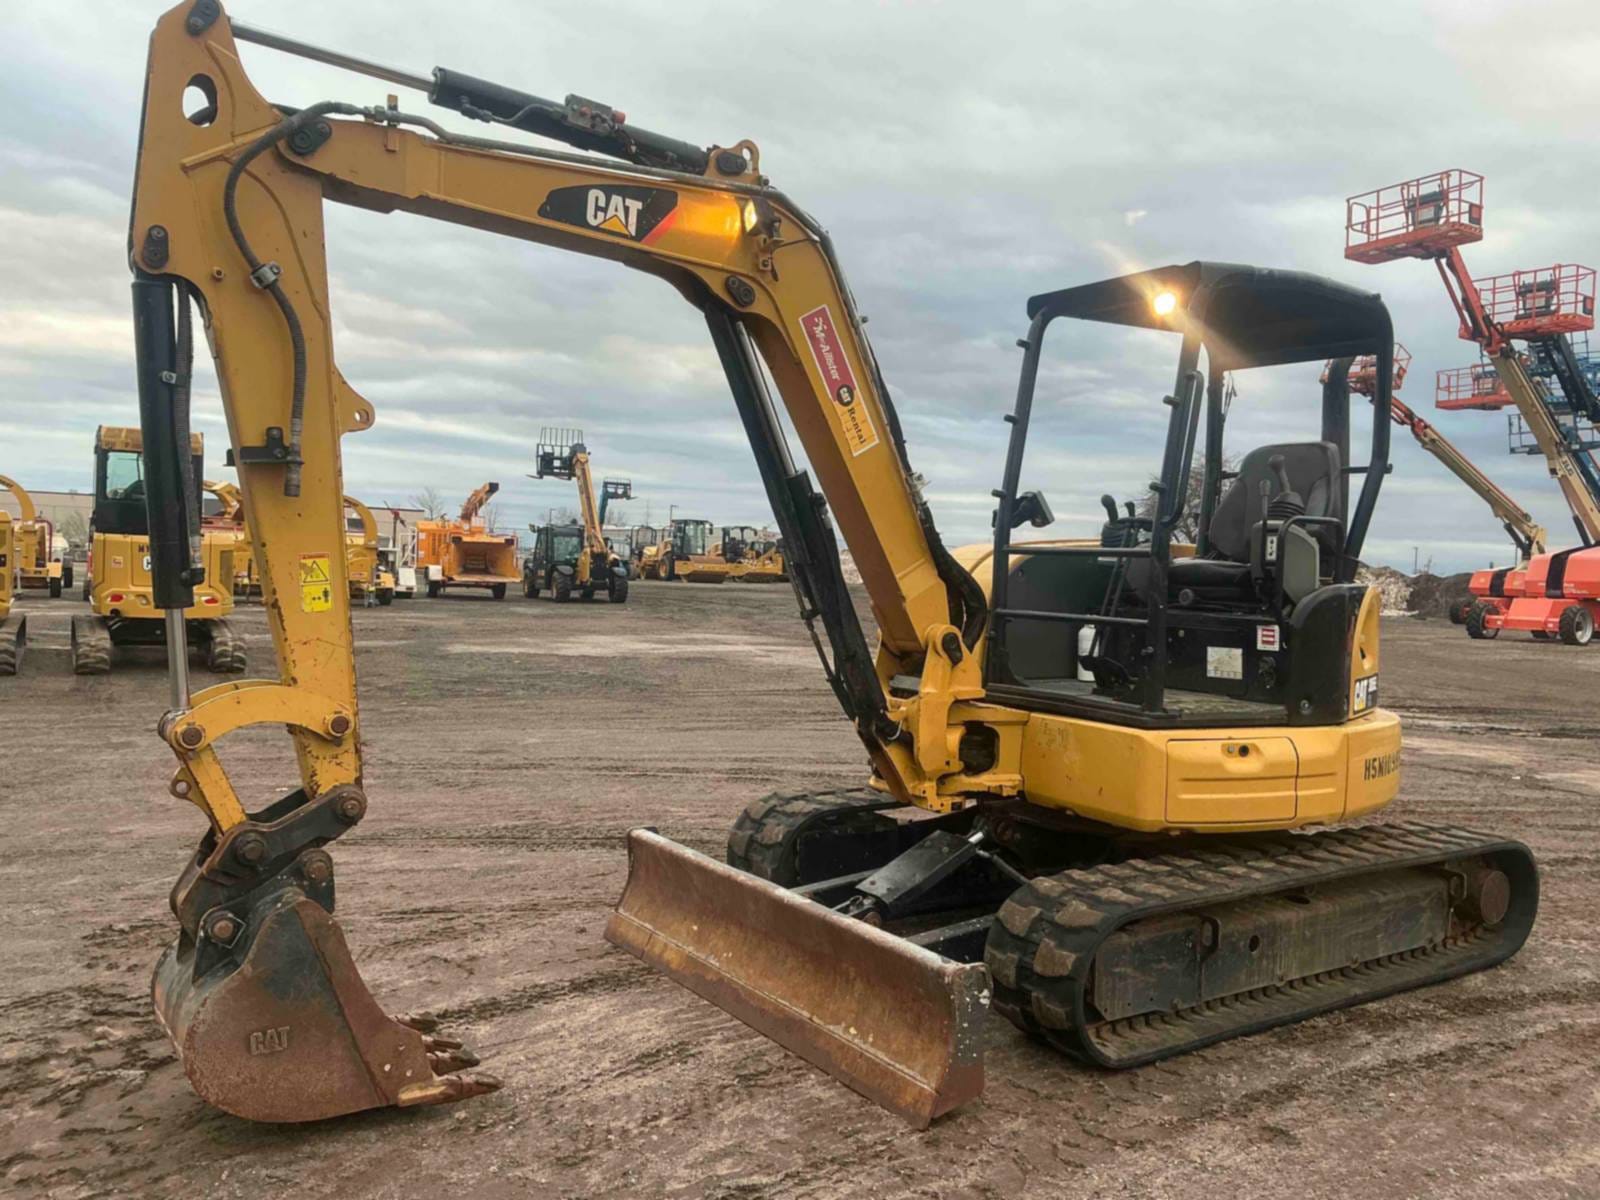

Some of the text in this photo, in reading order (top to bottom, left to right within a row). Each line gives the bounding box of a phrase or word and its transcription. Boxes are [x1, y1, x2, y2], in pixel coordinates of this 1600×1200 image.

[586, 188, 643, 237] CAT
[848, 407, 867, 445] Rental
[250, 1026, 290, 1055] CAT
